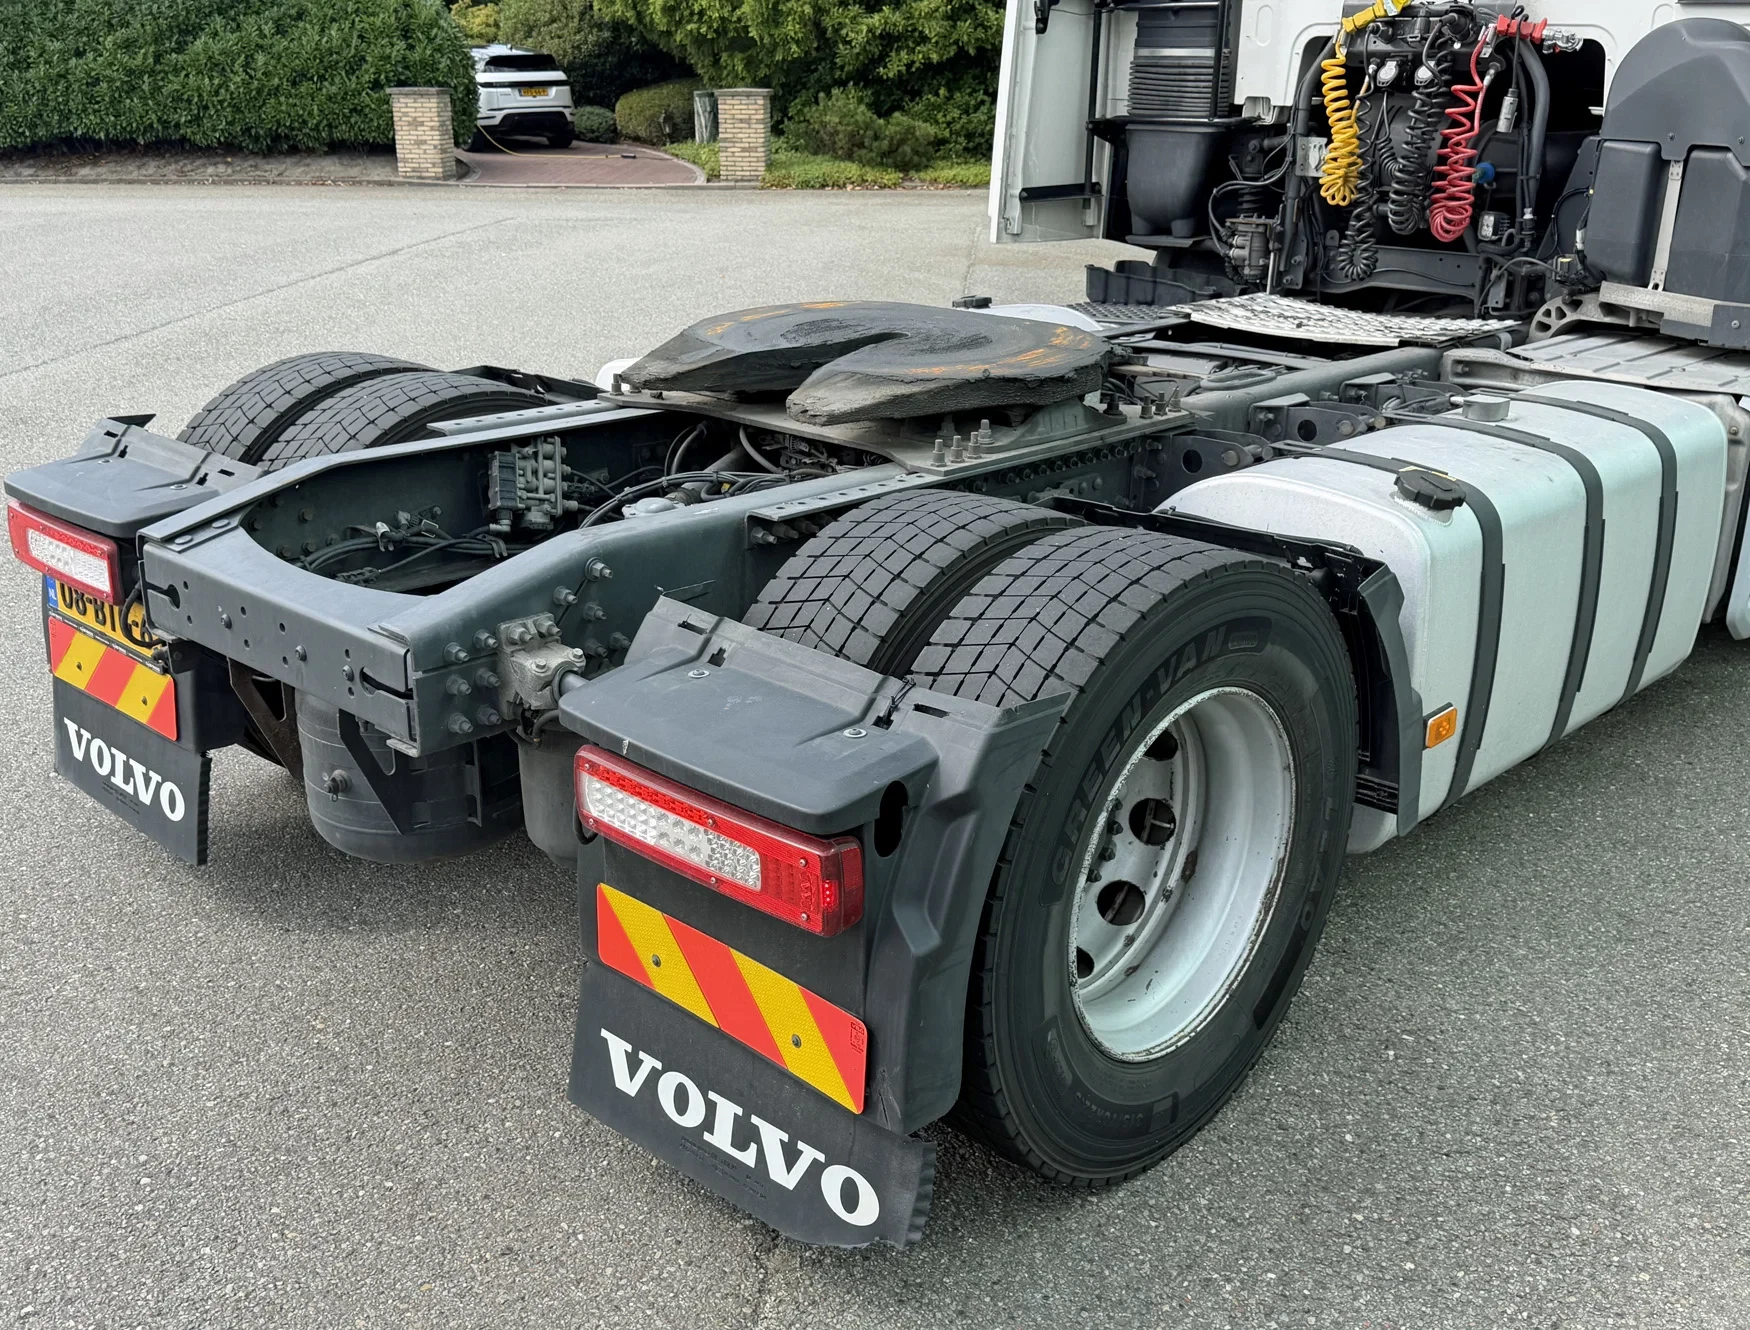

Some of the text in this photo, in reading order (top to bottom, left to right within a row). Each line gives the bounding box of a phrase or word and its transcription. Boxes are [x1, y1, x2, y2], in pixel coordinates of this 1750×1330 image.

[48, 588, 58, 600] NL
[63, 716, 186, 822] VOLVO
[600, 1028, 880, 1227] VOLVO
